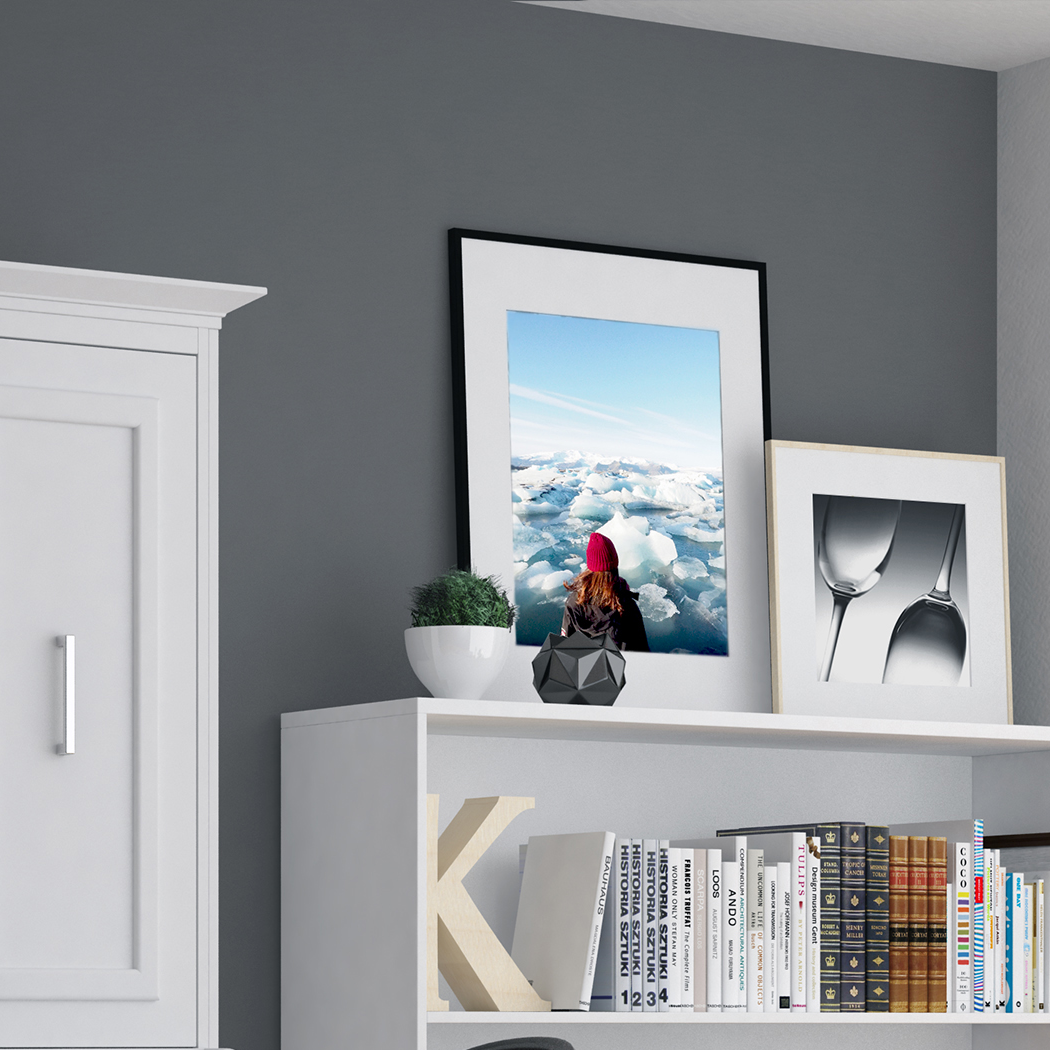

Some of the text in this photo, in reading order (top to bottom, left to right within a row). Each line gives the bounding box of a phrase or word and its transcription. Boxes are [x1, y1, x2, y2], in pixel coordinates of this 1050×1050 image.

[597, 856, 611, 915] BAUHAUS
[620, 845, 629, 1004] HISTORIA SZTUKI 1
[632, 845, 641, 1006] HISTORIA SZTUKI 2
[647, 852, 656, 1006] HISTORIA SZTUKI 3
[659, 849, 668, 1003] HISTORIA SZTUKI 4
[798, 919, 802, 929] BY
